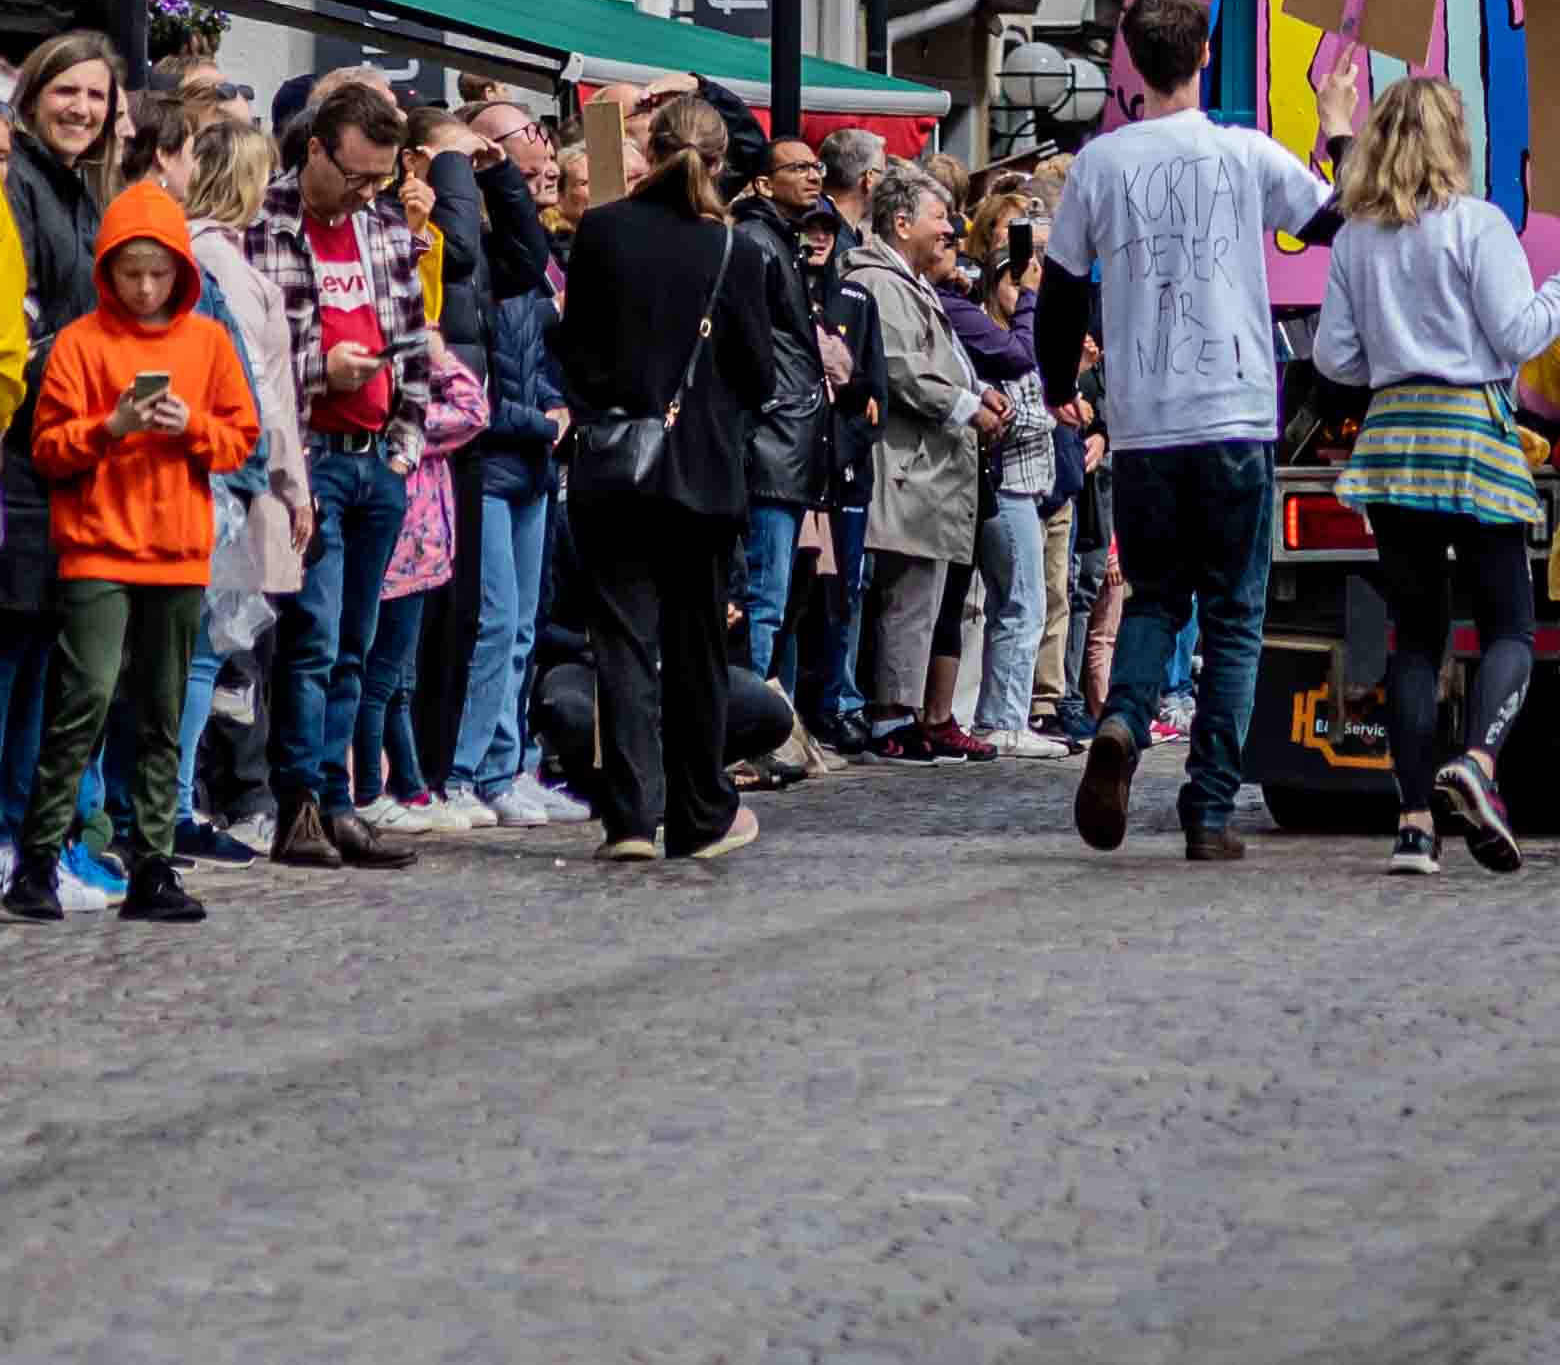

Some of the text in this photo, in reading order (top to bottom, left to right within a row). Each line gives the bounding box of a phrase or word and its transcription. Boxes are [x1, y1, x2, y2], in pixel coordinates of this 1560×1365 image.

[1121, 155, 1241, 242] KORTA
[1112, 233, 1233, 288] TJEJER
[1344, 722, 1385, 737] Servic
